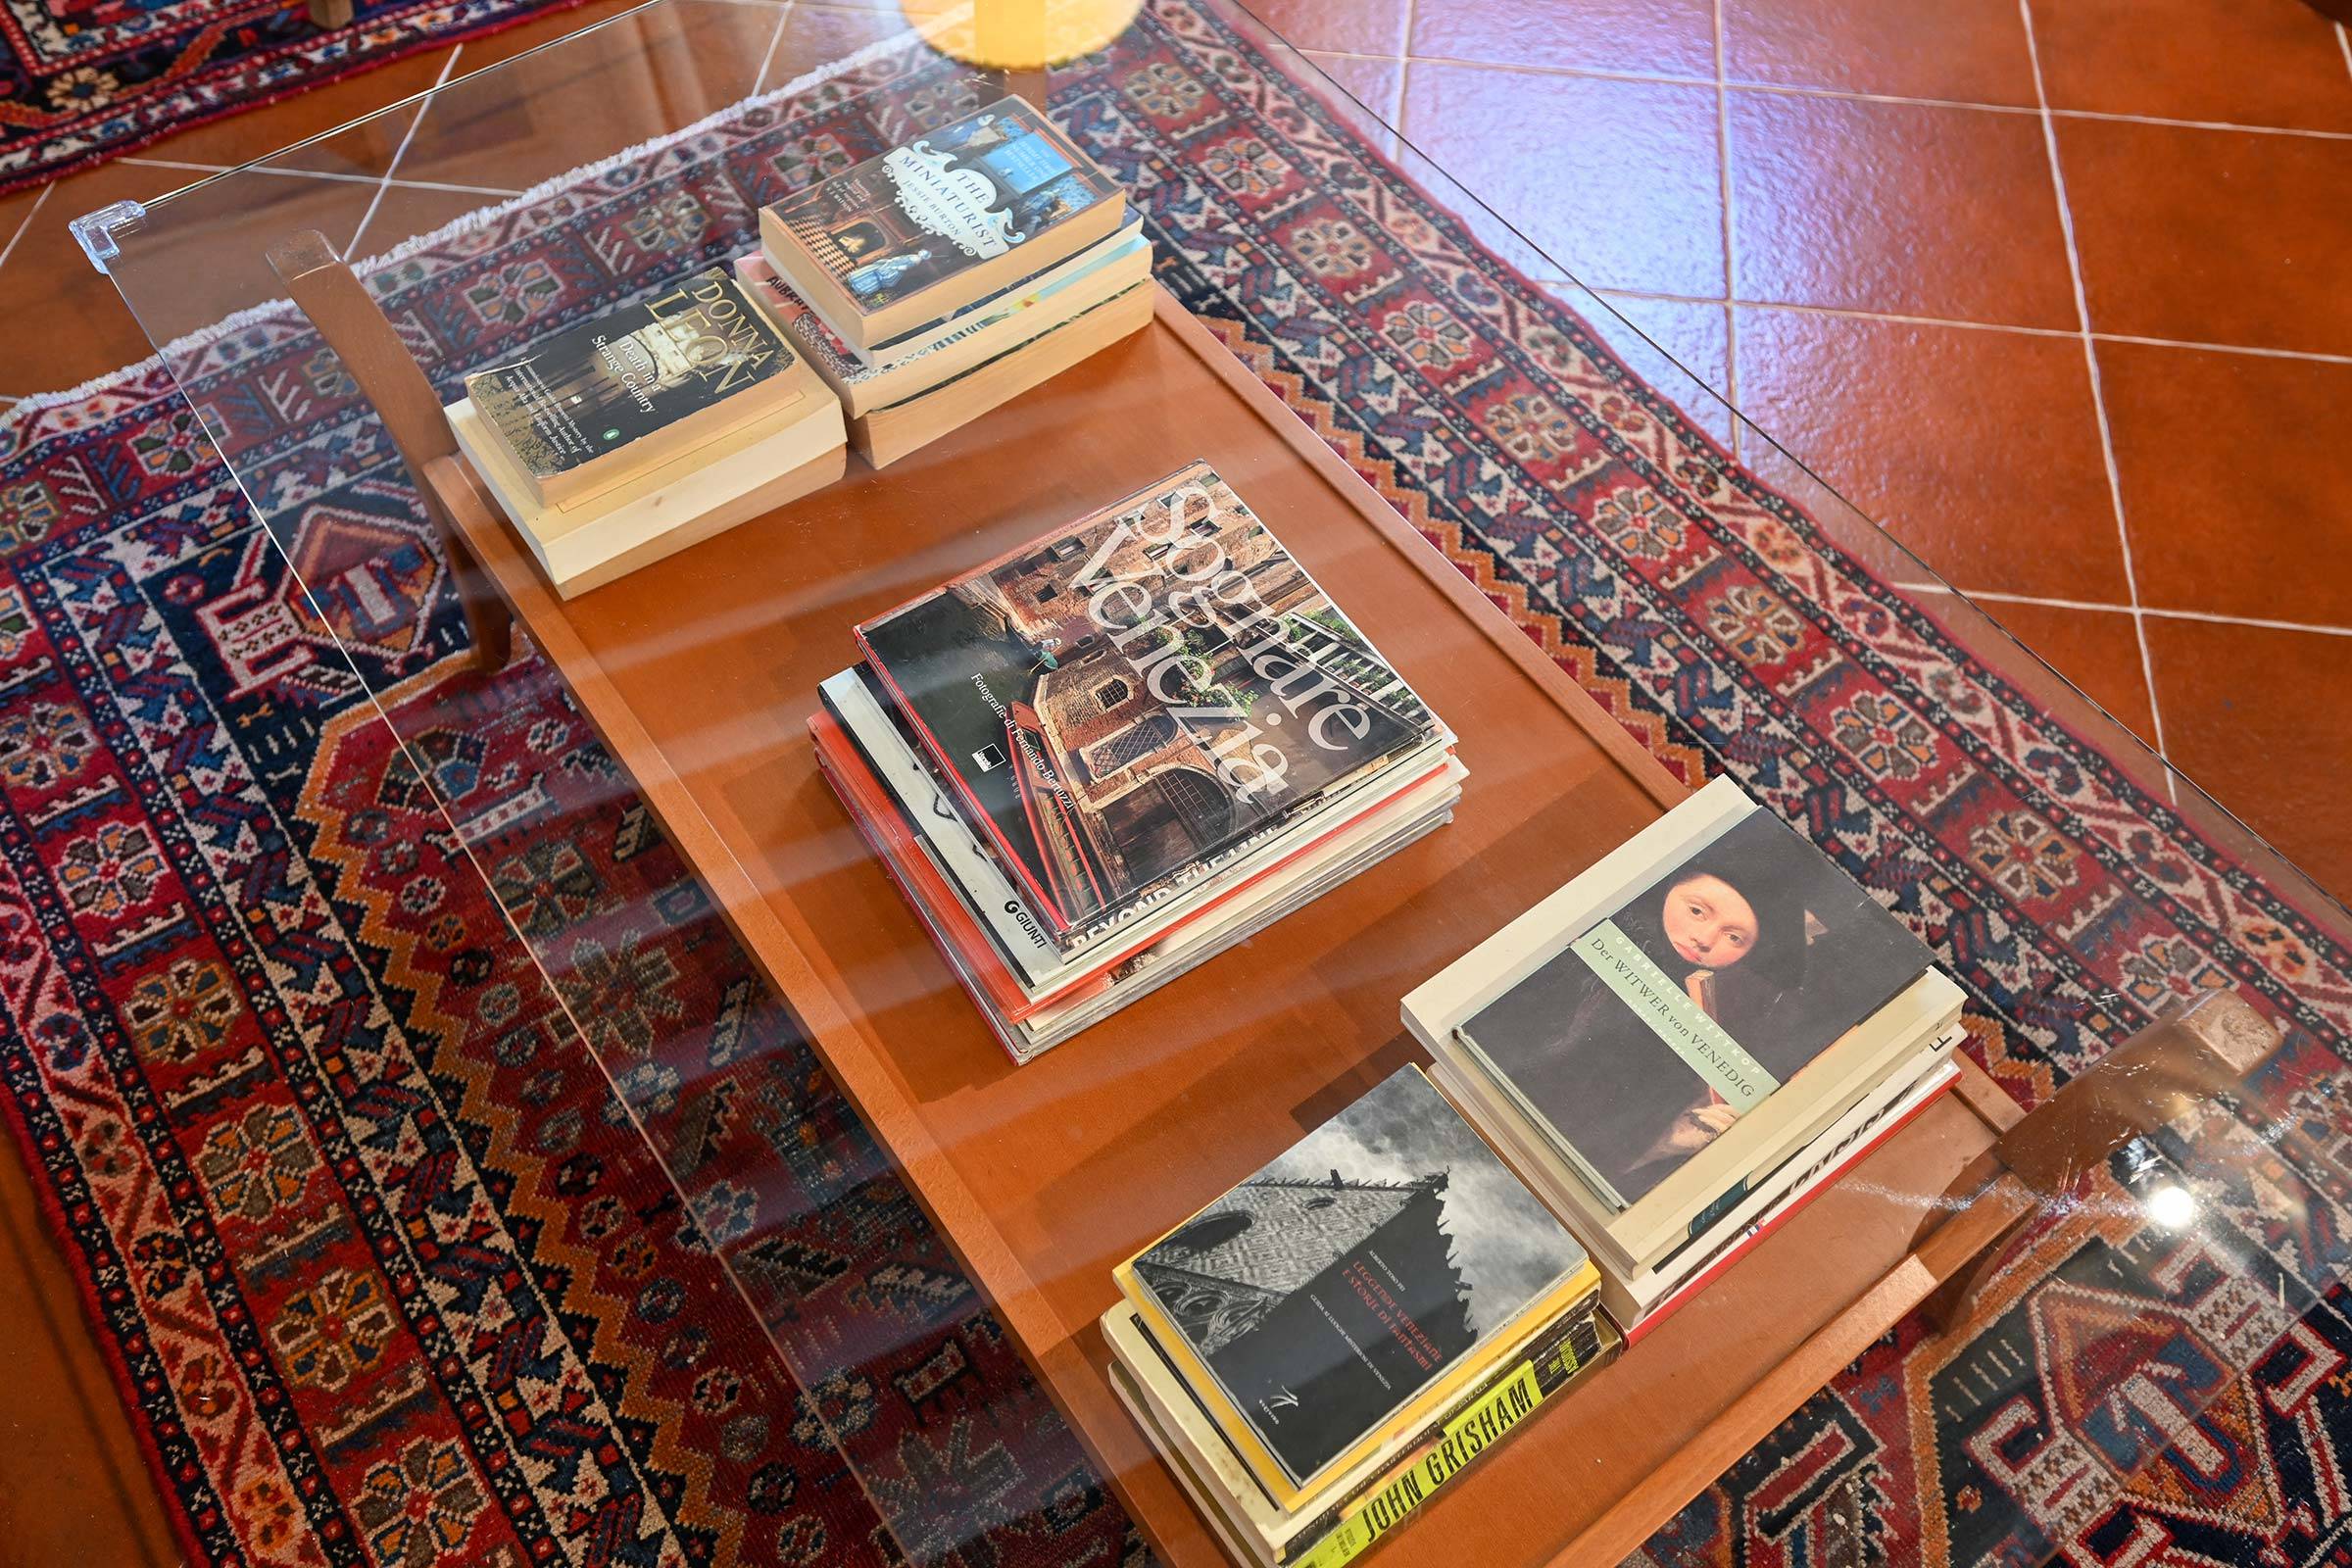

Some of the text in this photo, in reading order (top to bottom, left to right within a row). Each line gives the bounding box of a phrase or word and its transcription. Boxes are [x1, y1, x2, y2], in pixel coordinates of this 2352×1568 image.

[900, 157, 997, 247] MINIATURIST
[903, 180, 931, 204] JESSIE
[929, 204, 962, 235] BURTON
[957, 172, 989, 203] THE
[619, 339, 661, 392] Death in a
[644, 288, 756, 394] LEON
[692, 281, 774, 369] DONNA
[592, 335, 656, 414] Strange Country
[559, 426, 575, 446] Author
[570, 444, 583, 454] of
[567, 418, 583, 438] Mystery
[580, 437, 588, 446] by
[585, 444, 594, 454] the
[1069, 503, 1289, 804] Venezia
[1138, 490, 1371, 751] Sognare
[971, 672, 1006, 719] Fotografie
[1004, 719, 1017, 731] di
[1011, 727, 1045, 770] Fernando
[1016, 912, 1047, 949] GIUNTI
[1592, 938, 1613, 960] Der
[1615, 959, 1670, 1016] WITWER
[1668, 1015, 1690, 1037] von
[1690, 1034, 1754, 1097] VENEDIG
[1616, 936, 1693, 1009] GABRIELLE
[1695, 1013, 1760, 1074] WITTKOP
[1348, 1277, 1380, 1311] STORIE
[1378, 1310, 1392, 1325] DI
[1389, 1324, 1433, 1371] FANTASMI
[1352, 1260, 1443, 1362] LEGGENDE VENEZIANE
[1362, 1470, 1423, 1543] JOHN
[1426, 1377, 1534, 1487] GRISHAM
